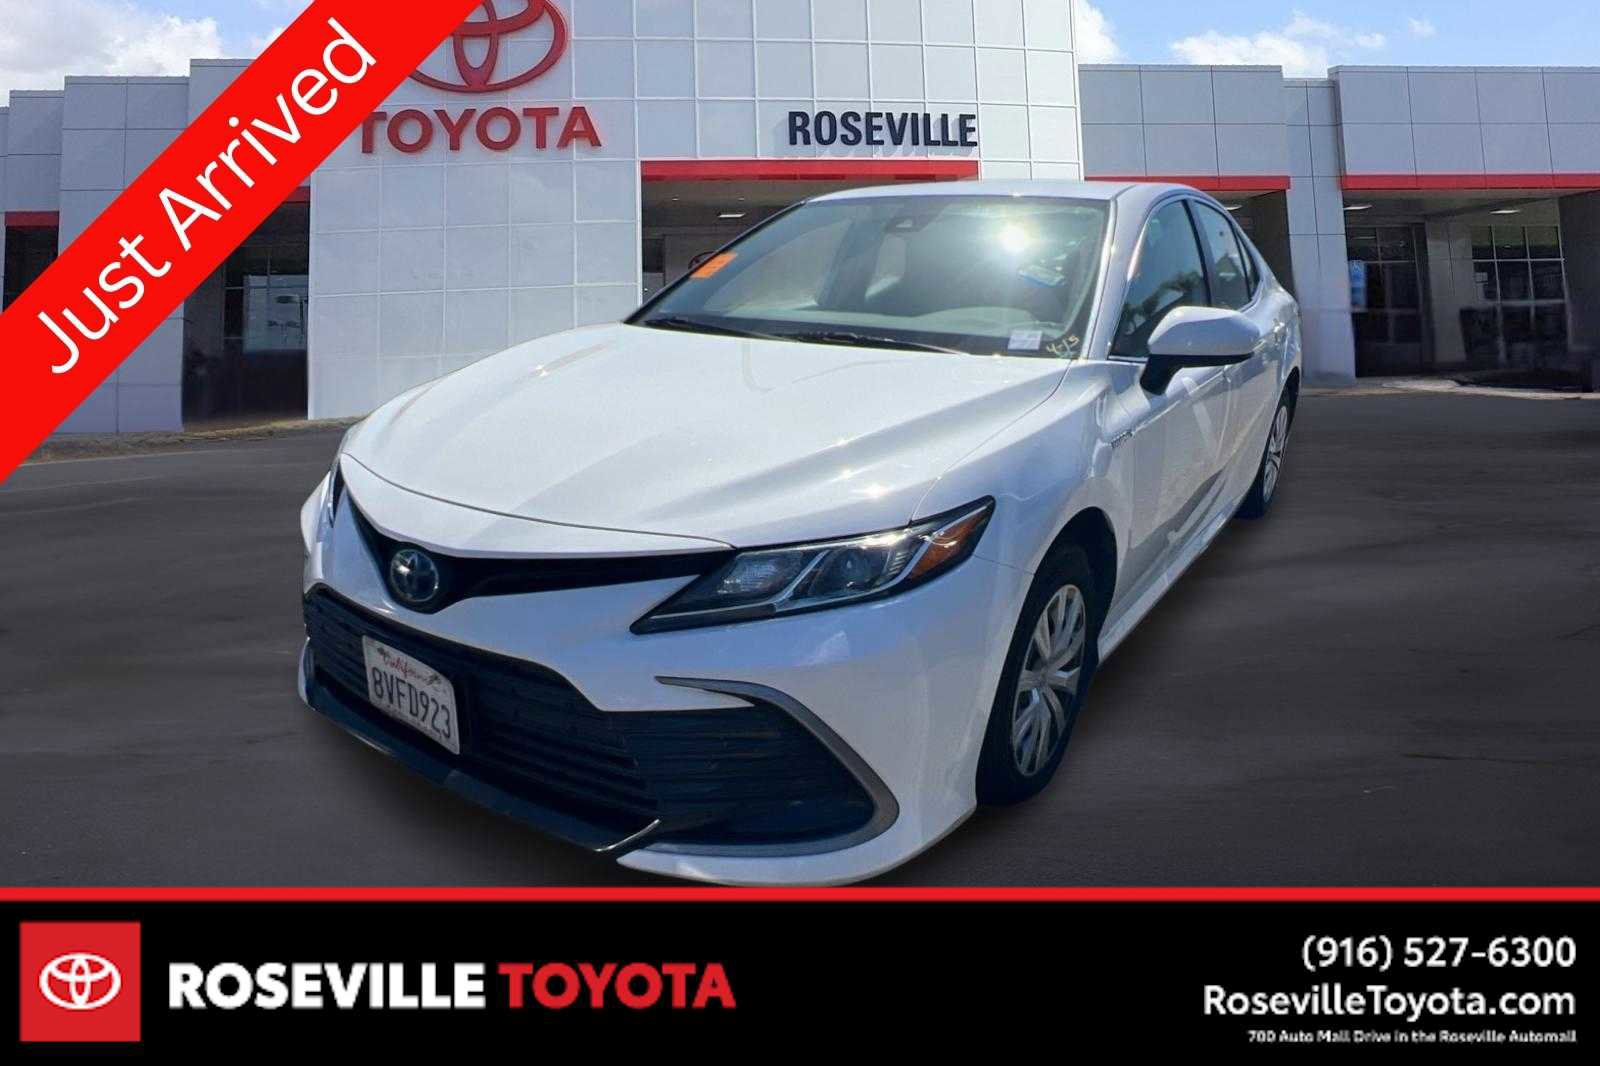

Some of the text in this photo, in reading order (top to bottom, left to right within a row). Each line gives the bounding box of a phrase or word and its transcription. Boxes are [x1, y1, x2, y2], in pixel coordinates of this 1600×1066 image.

[361, 106, 602, 154] TOYOTA
[788, 111, 978, 147] ROSEVILLE
[371, 666, 451, 739] 8VFD923
